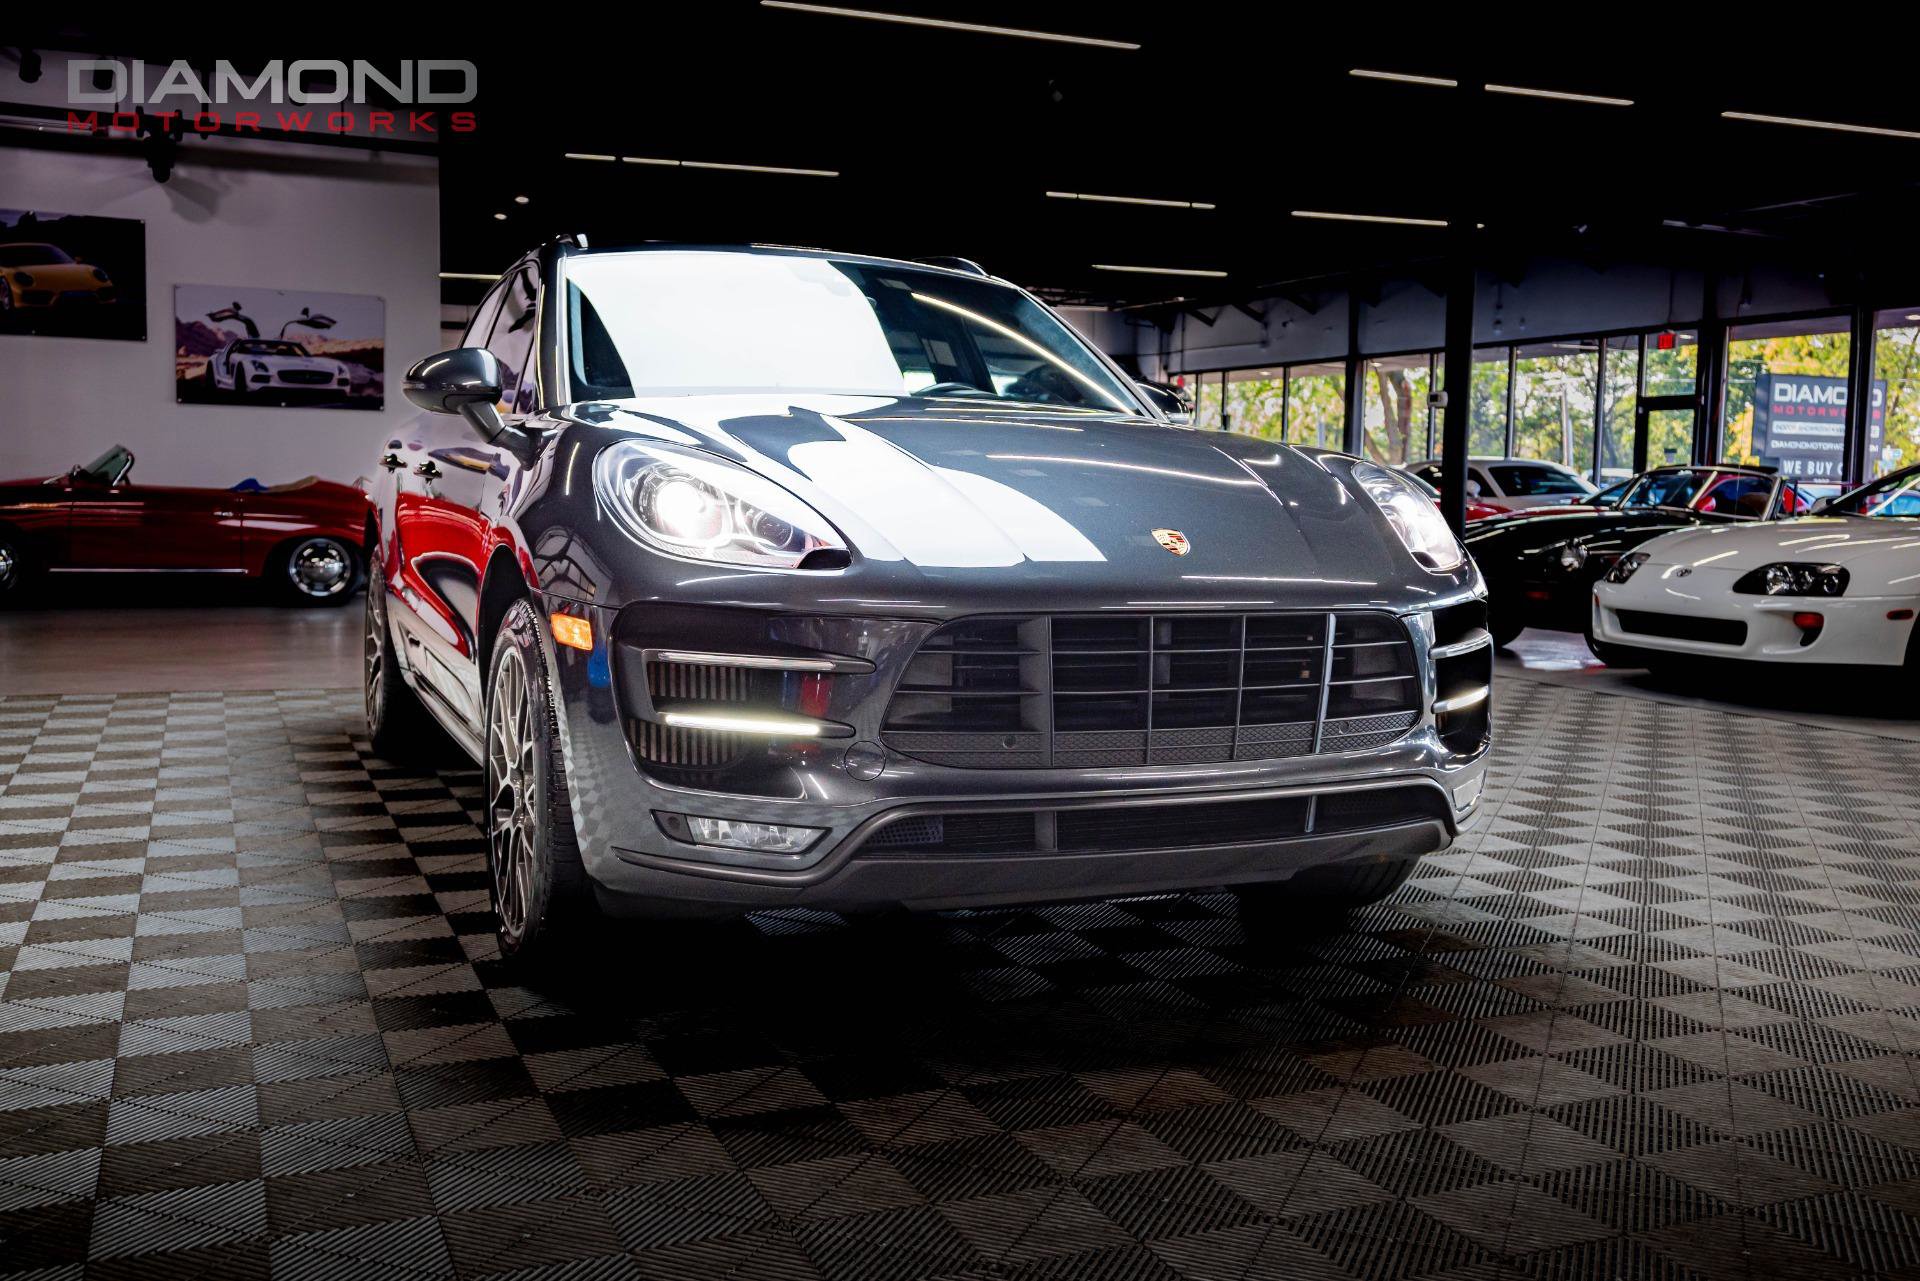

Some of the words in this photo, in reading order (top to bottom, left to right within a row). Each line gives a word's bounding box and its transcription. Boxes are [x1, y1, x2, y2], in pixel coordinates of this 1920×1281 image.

[1774, 383, 1883, 408] DIAMOD
[1783, 460, 1802, 475] WE
[1807, 461, 1833, 476] BUY
